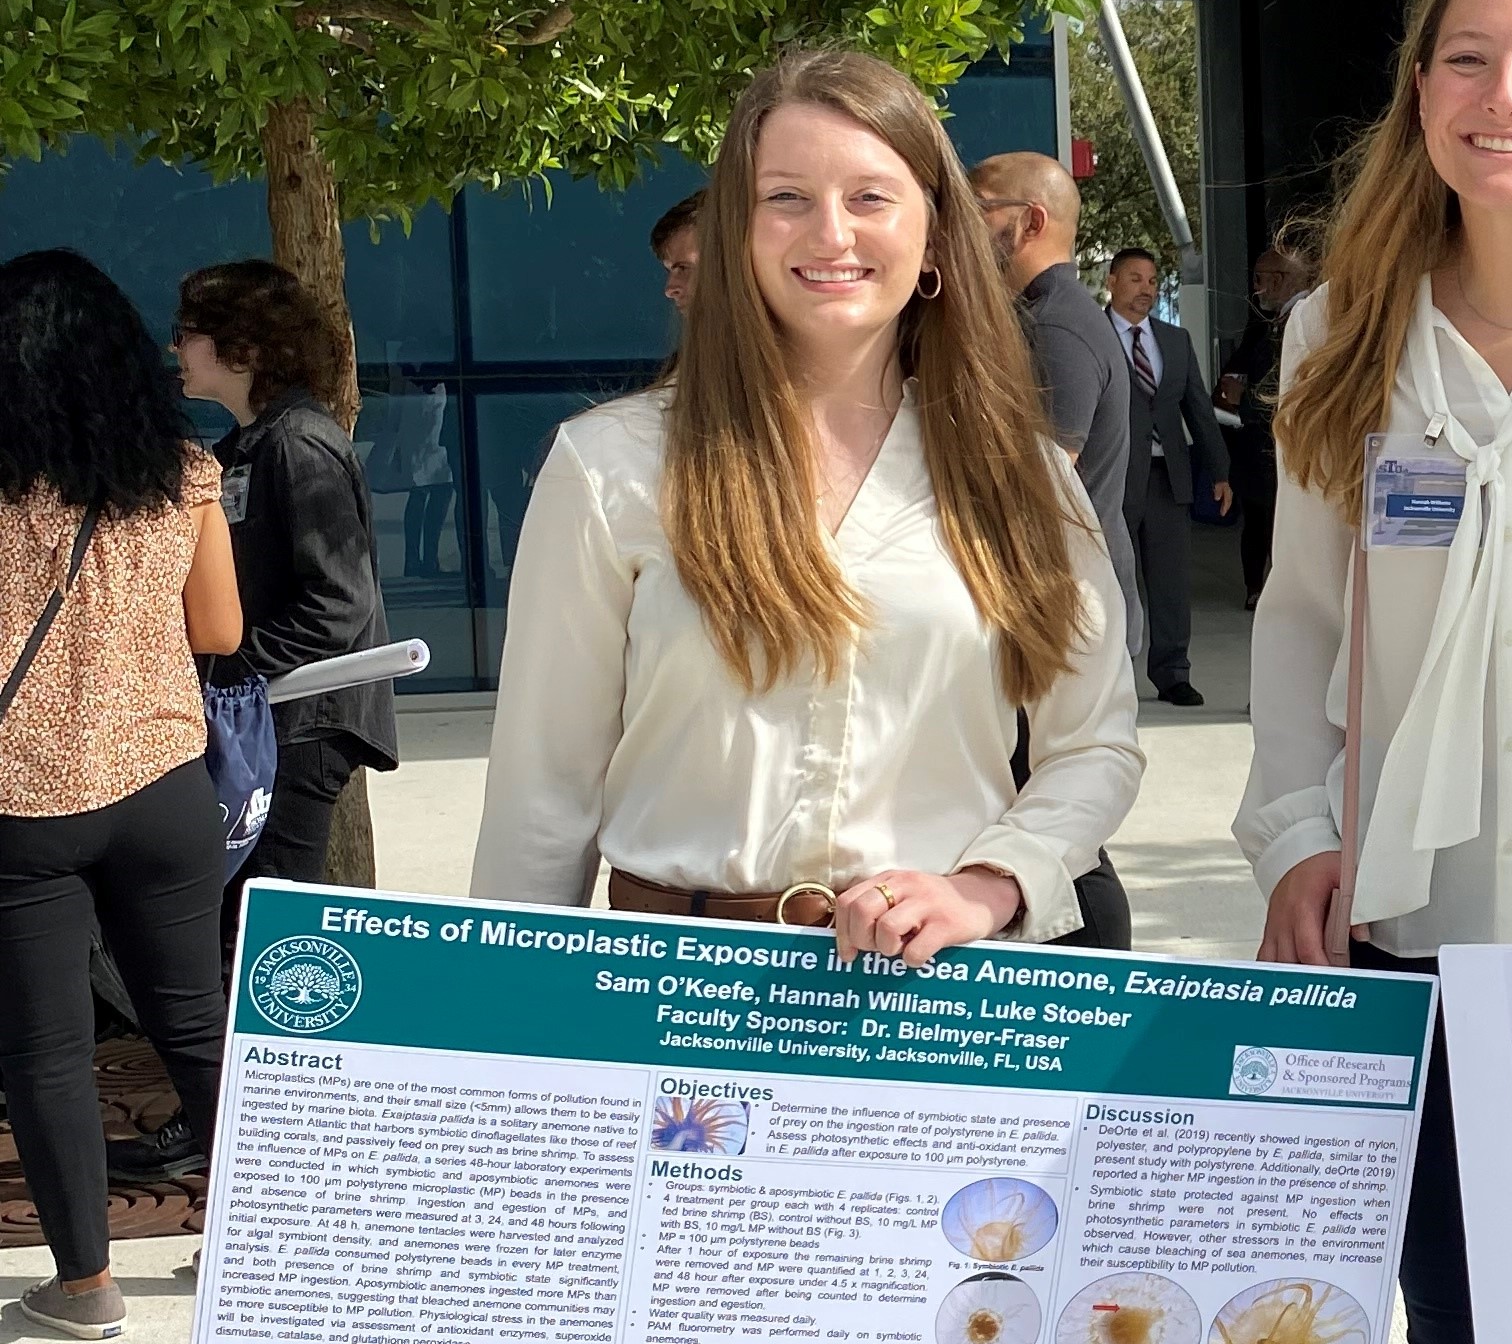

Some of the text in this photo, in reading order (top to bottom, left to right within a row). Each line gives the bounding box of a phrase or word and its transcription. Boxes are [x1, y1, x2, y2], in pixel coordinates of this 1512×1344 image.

[258, 941, 356, 982] JACKSONVILLE
[321, 906, 430, 939] Effects
[439, 918, 474, 943] of
[480, 920, 668, 959] Microplastic
[675, 936, 818, 970] Exposure
[862, 952, 908, 977] the
[917, 957, 968, 982] Sea
[974, 959, 1116, 995] Anemone,
[1123, 970, 1264, 1002] Exaiptasia
[1268, 983, 1357, 1009] pallida
[255, 976, 267, 984] 19
[344, 984, 357, 992] 34
[258, 992, 349, 1028] UNIVERSITY
[595, 970, 1132, 1028] Sam O'Keefe, Hannah Williams, Luke Stoeber
[656, 1004, 1070, 1050] Faculty Sponsor: Dr. Bielmyer-Fraser
[243, 1046, 343, 1070] Abstract
[658, 1030, 1063, 1072] Jacksonville University, Jacksonville, FL, USA
[1285, 1052, 1386, 1072] Office of Research
[244, 1069, 642, 1108] Microplastics (MPs) are one of the most common forms of pollution found in
[660, 1077, 774, 1101] Objectives
[1282, 1069, 1411, 1090] & Sponsored Programs
[771, 1101, 1071, 1129] Determine the influence of symbiotic state and presence
[1085, 1103, 1195, 1126] Discussion
[1098, 1124, 1138, 1137] DeOrte
[1142, 1127, 1153, 1137] et
[1174, 1128, 1210, 1143] (2019)
[1213, 1132, 1256, 1145] recently
[1259, 1133, 1301, 1145] showed
[1303, 1135, 1351, 1149] ingestion
[1354, 1138, 1366, 1148] of
[1368, 1139, 1398, 1152] nylon,
[651, 1160, 743, 1182] Methods
